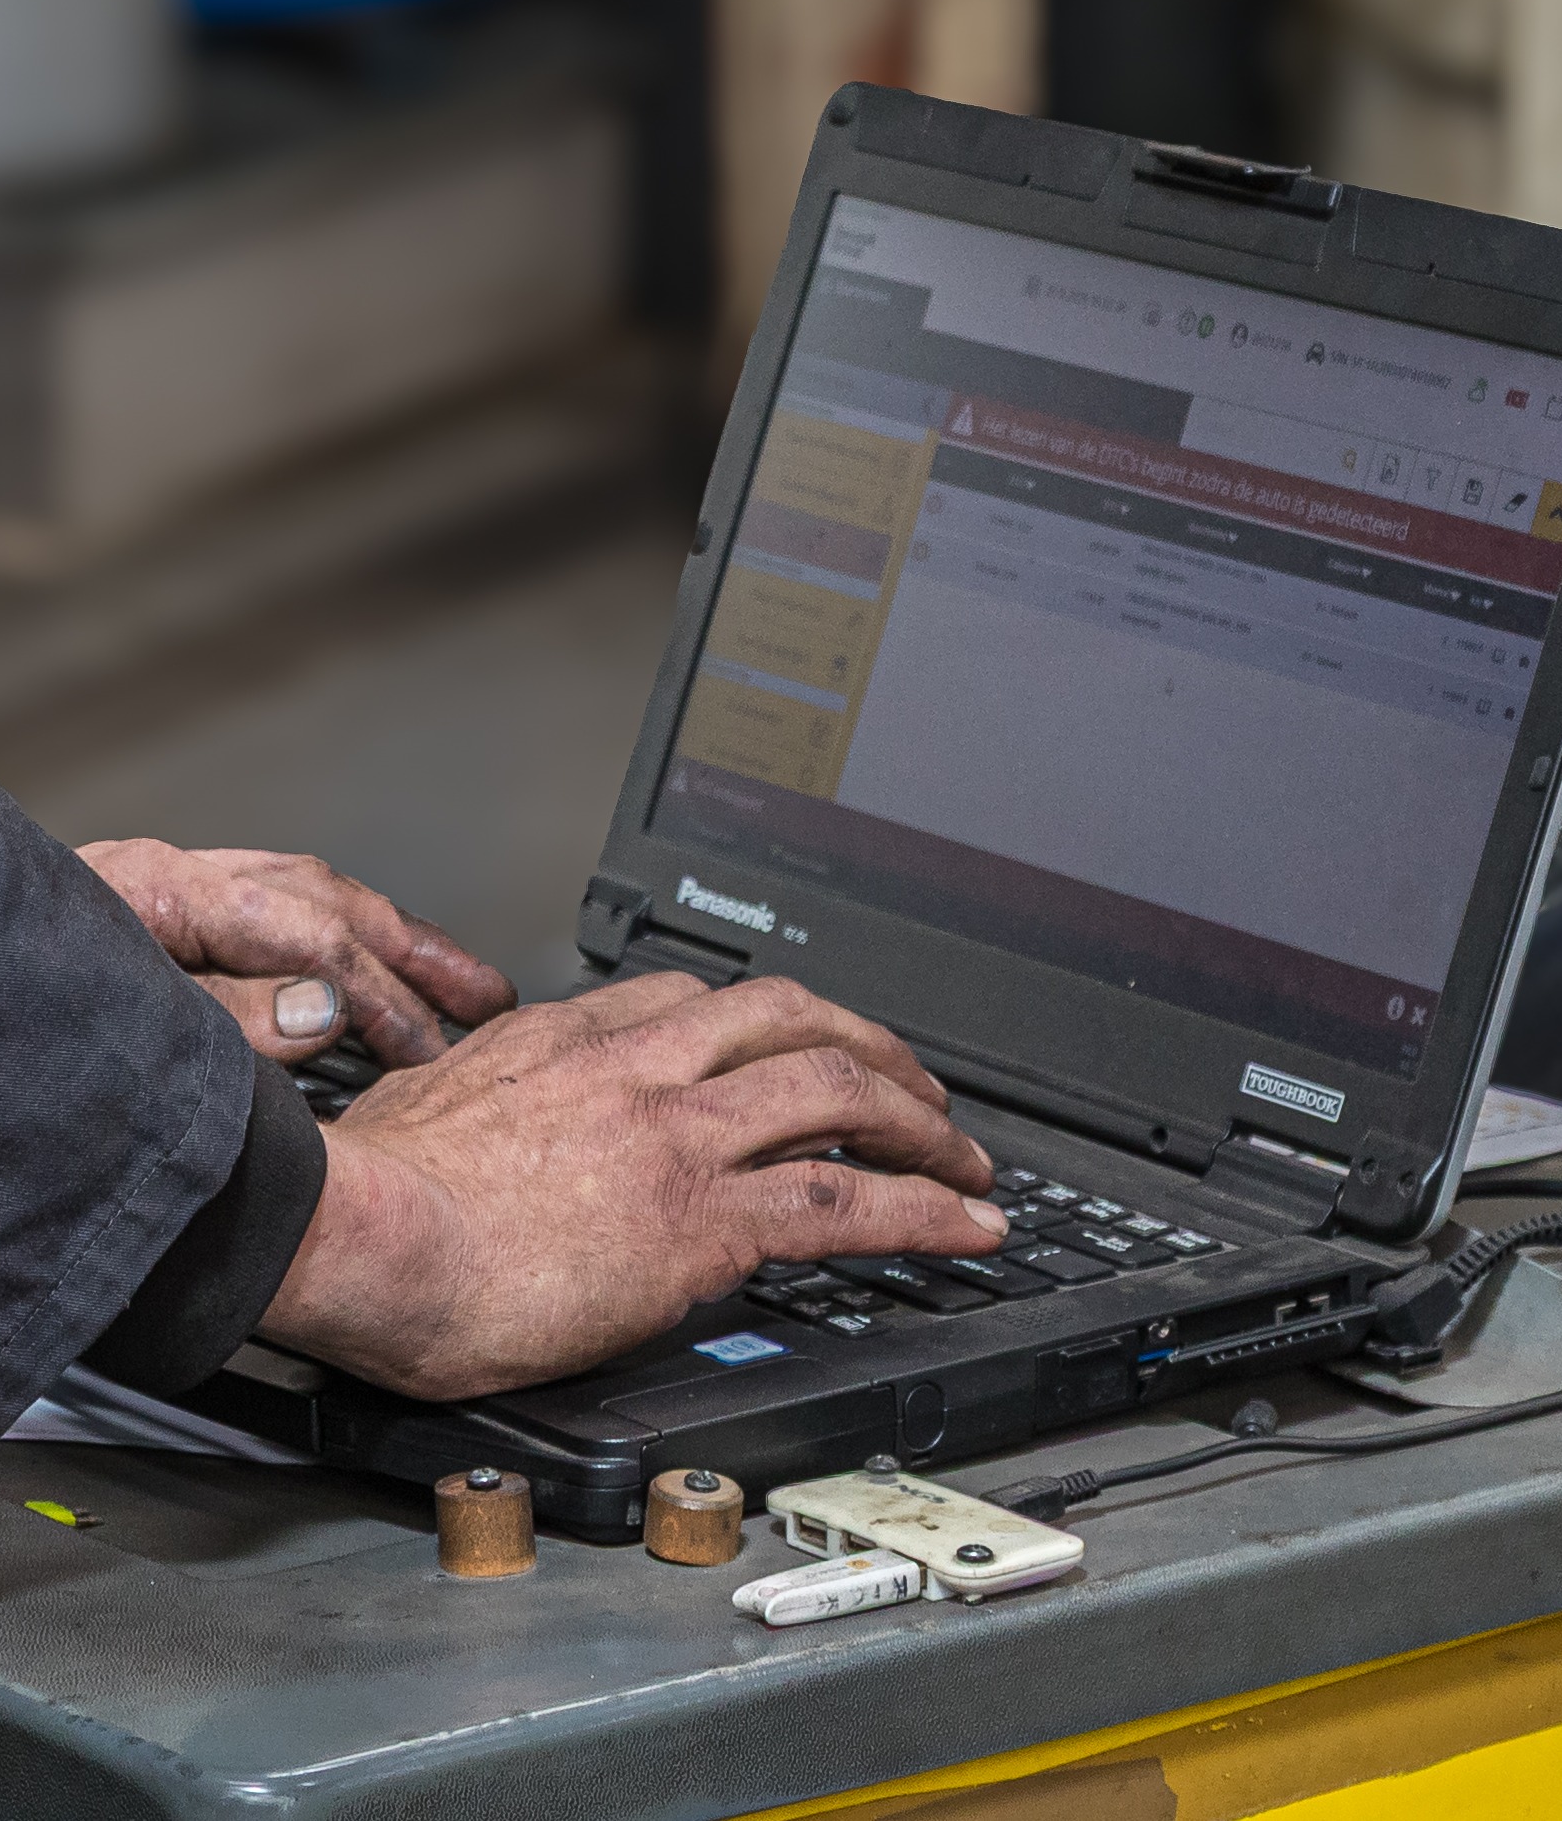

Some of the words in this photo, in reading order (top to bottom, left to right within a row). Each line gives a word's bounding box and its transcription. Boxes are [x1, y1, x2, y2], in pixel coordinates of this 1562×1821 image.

[1049, 436, 1075, 456] van
[1076, 439, 1098, 462] de
[1188, 468, 1233, 497] zodra
[1232, 478, 1256, 502] de
[1254, 485, 1292, 512] auto
[1292, 494, 1307, 516] is
[676, 875, 777, 933] Panasonic
[1249, 1072, 1339, 1115] TOUGHBOOK
